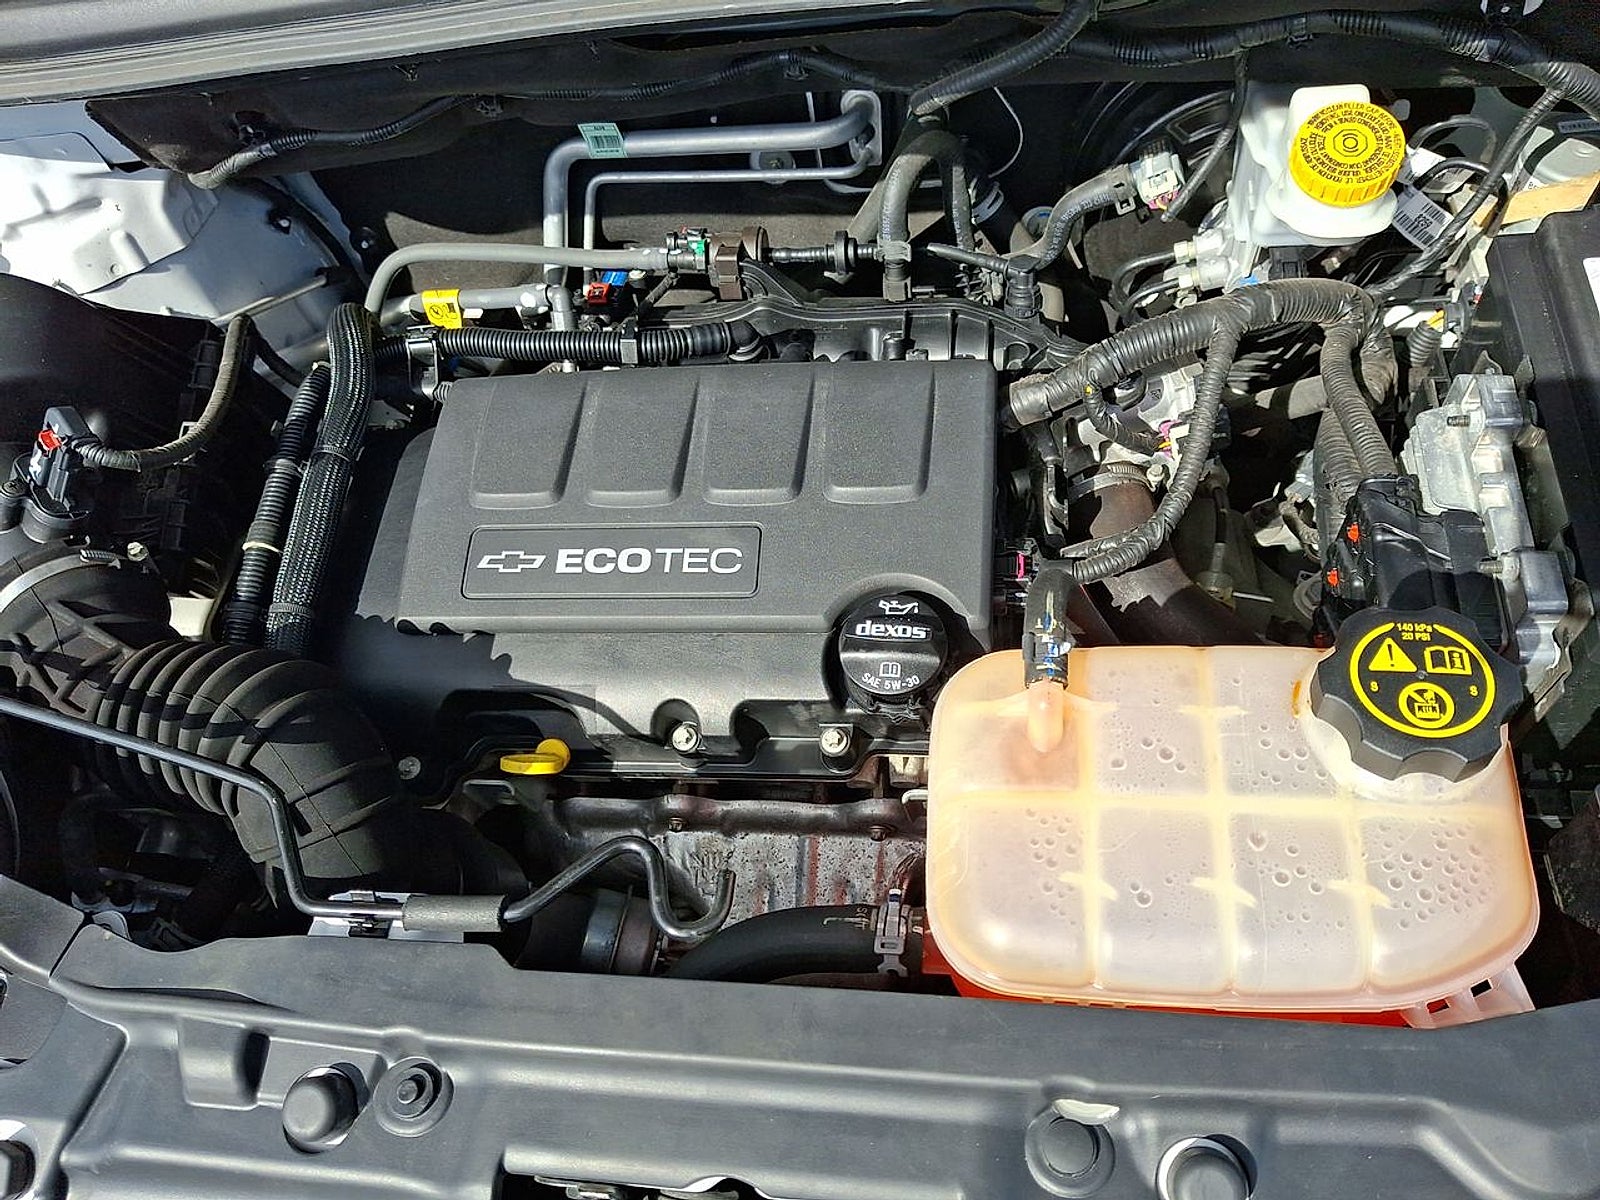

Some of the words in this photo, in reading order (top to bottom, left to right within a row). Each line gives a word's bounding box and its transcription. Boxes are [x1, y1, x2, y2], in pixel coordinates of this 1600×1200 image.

[555, 547, 743, 574] ECOTEC
[855, 620, 927, 639] dexos
[1397, 623, 1413, 631] 140
[862, 672, 881, 688] SAE
[884, 675, 920, 690] 5W-30
